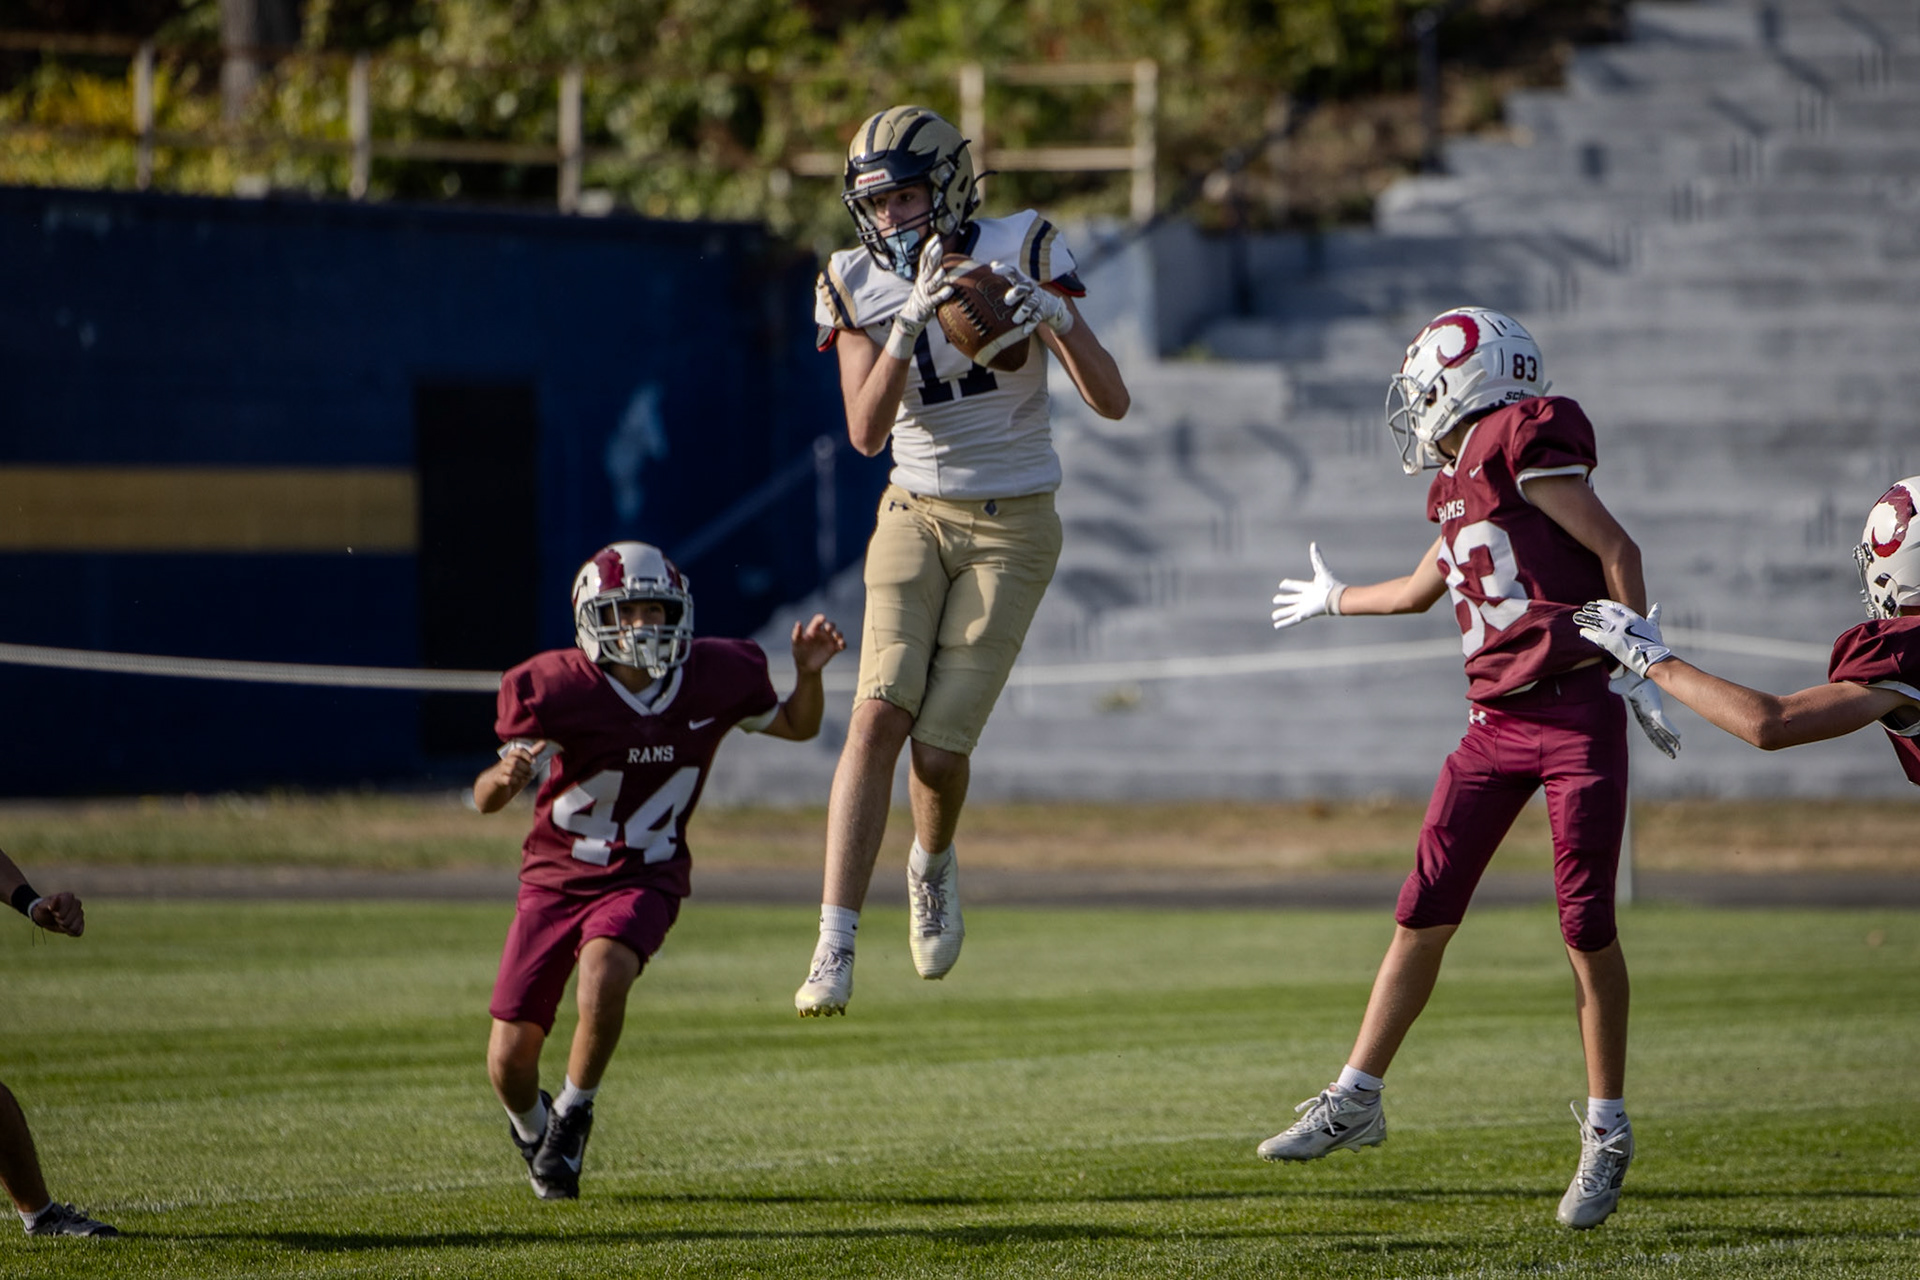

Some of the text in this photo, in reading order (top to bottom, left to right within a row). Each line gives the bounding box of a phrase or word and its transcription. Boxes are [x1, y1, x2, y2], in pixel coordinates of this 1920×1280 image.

[1513, 353, 1537, 382] 83
[627, 745, 675, 764] RAMS
[552, 766, 700, 867] 44
